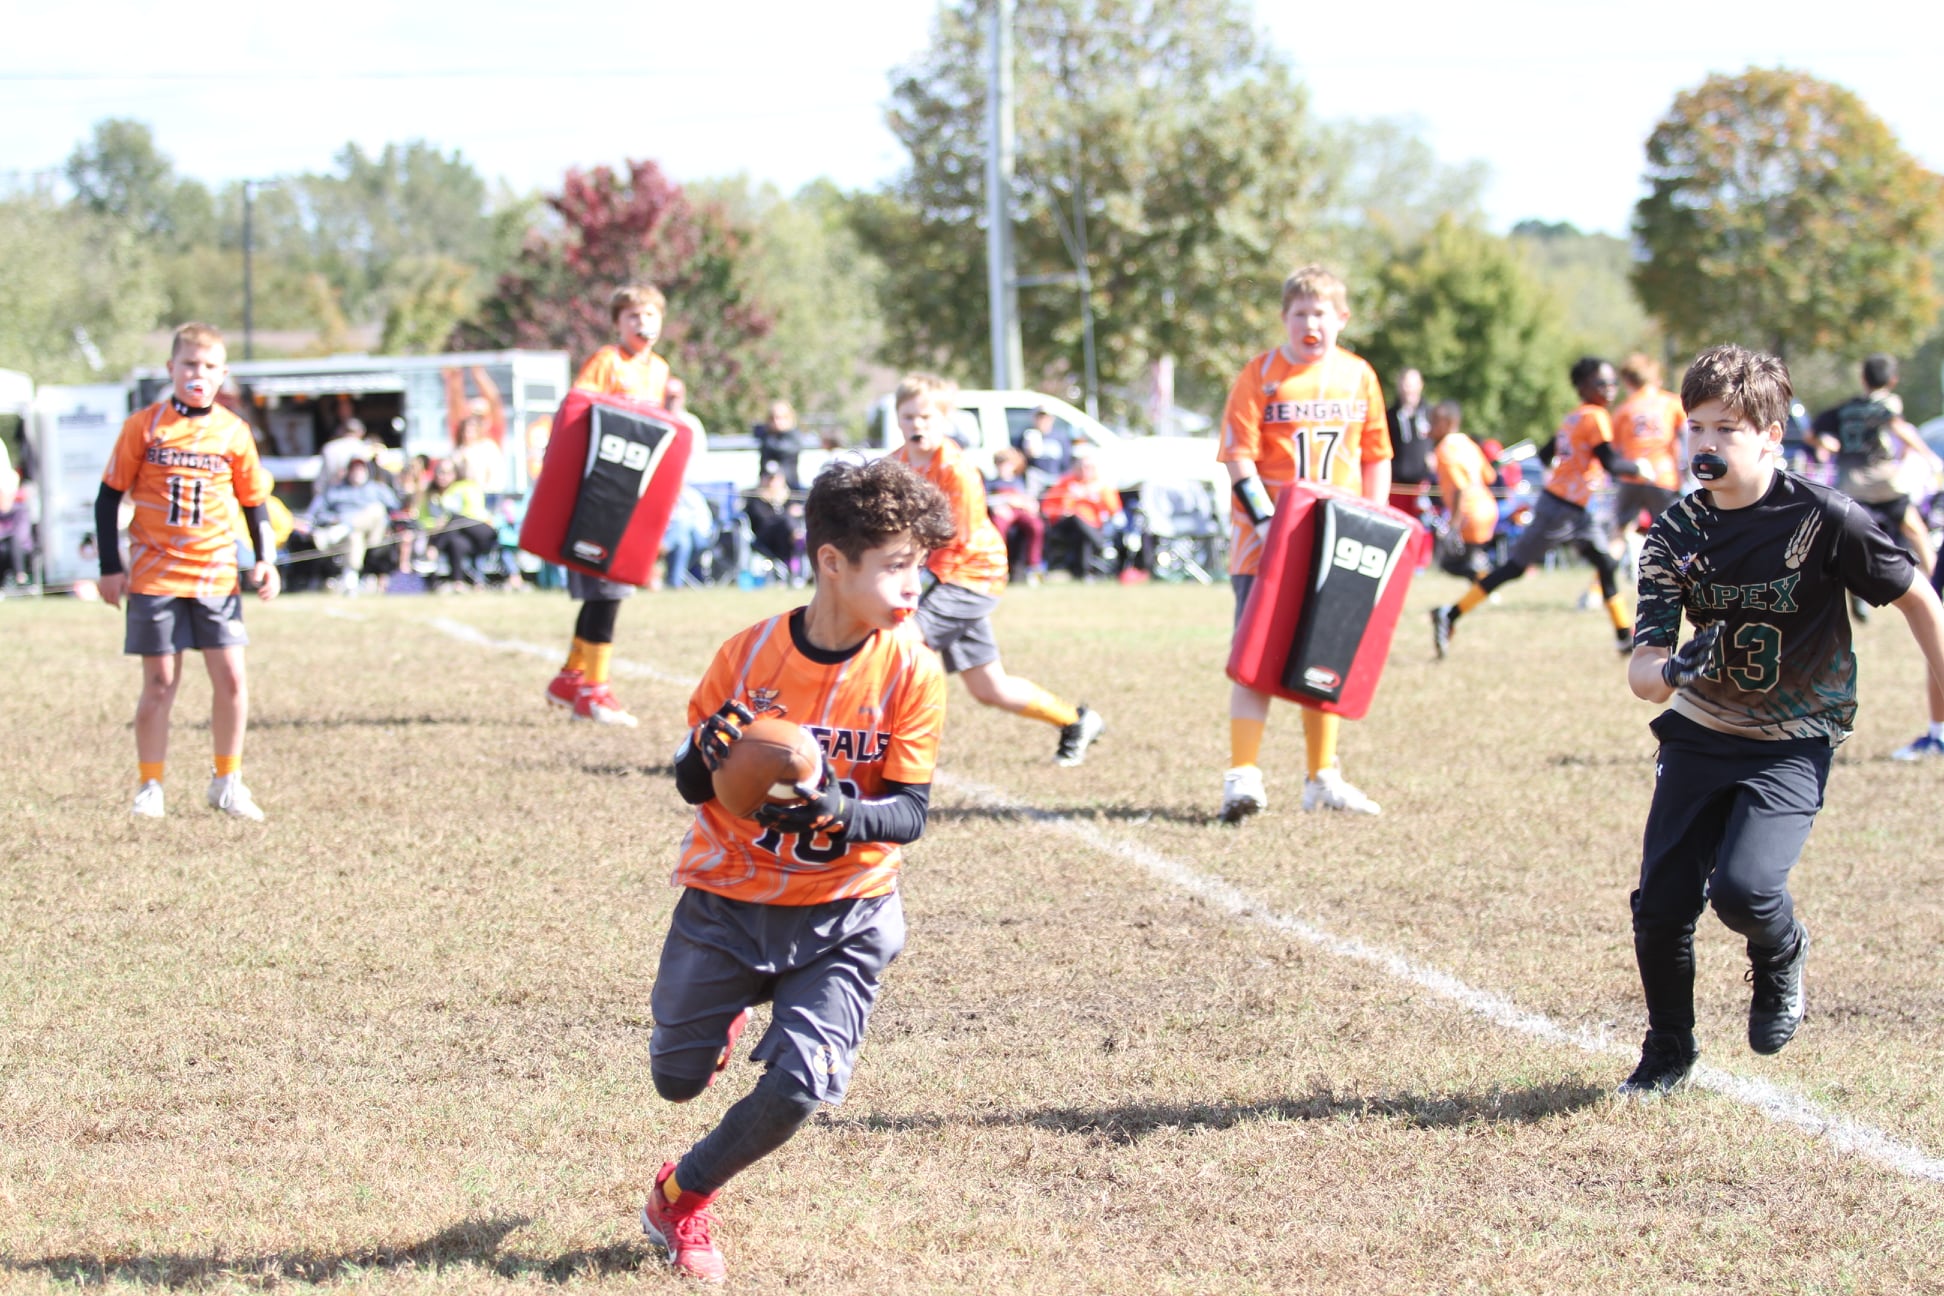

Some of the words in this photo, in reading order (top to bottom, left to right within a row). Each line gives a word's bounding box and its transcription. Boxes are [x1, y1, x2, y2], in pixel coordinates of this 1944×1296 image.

[1263, 401, 1367, 422] BENGALS
[146, 447, 232, 471] BENGAL
[598, 433, 651, 472] 99
[1294, 428, 1342, 482] 17
[167, 475, 204, 527] 11
[1333, 536, 1388, 579] 99
[1690, 571, 1801, 613] APEX
